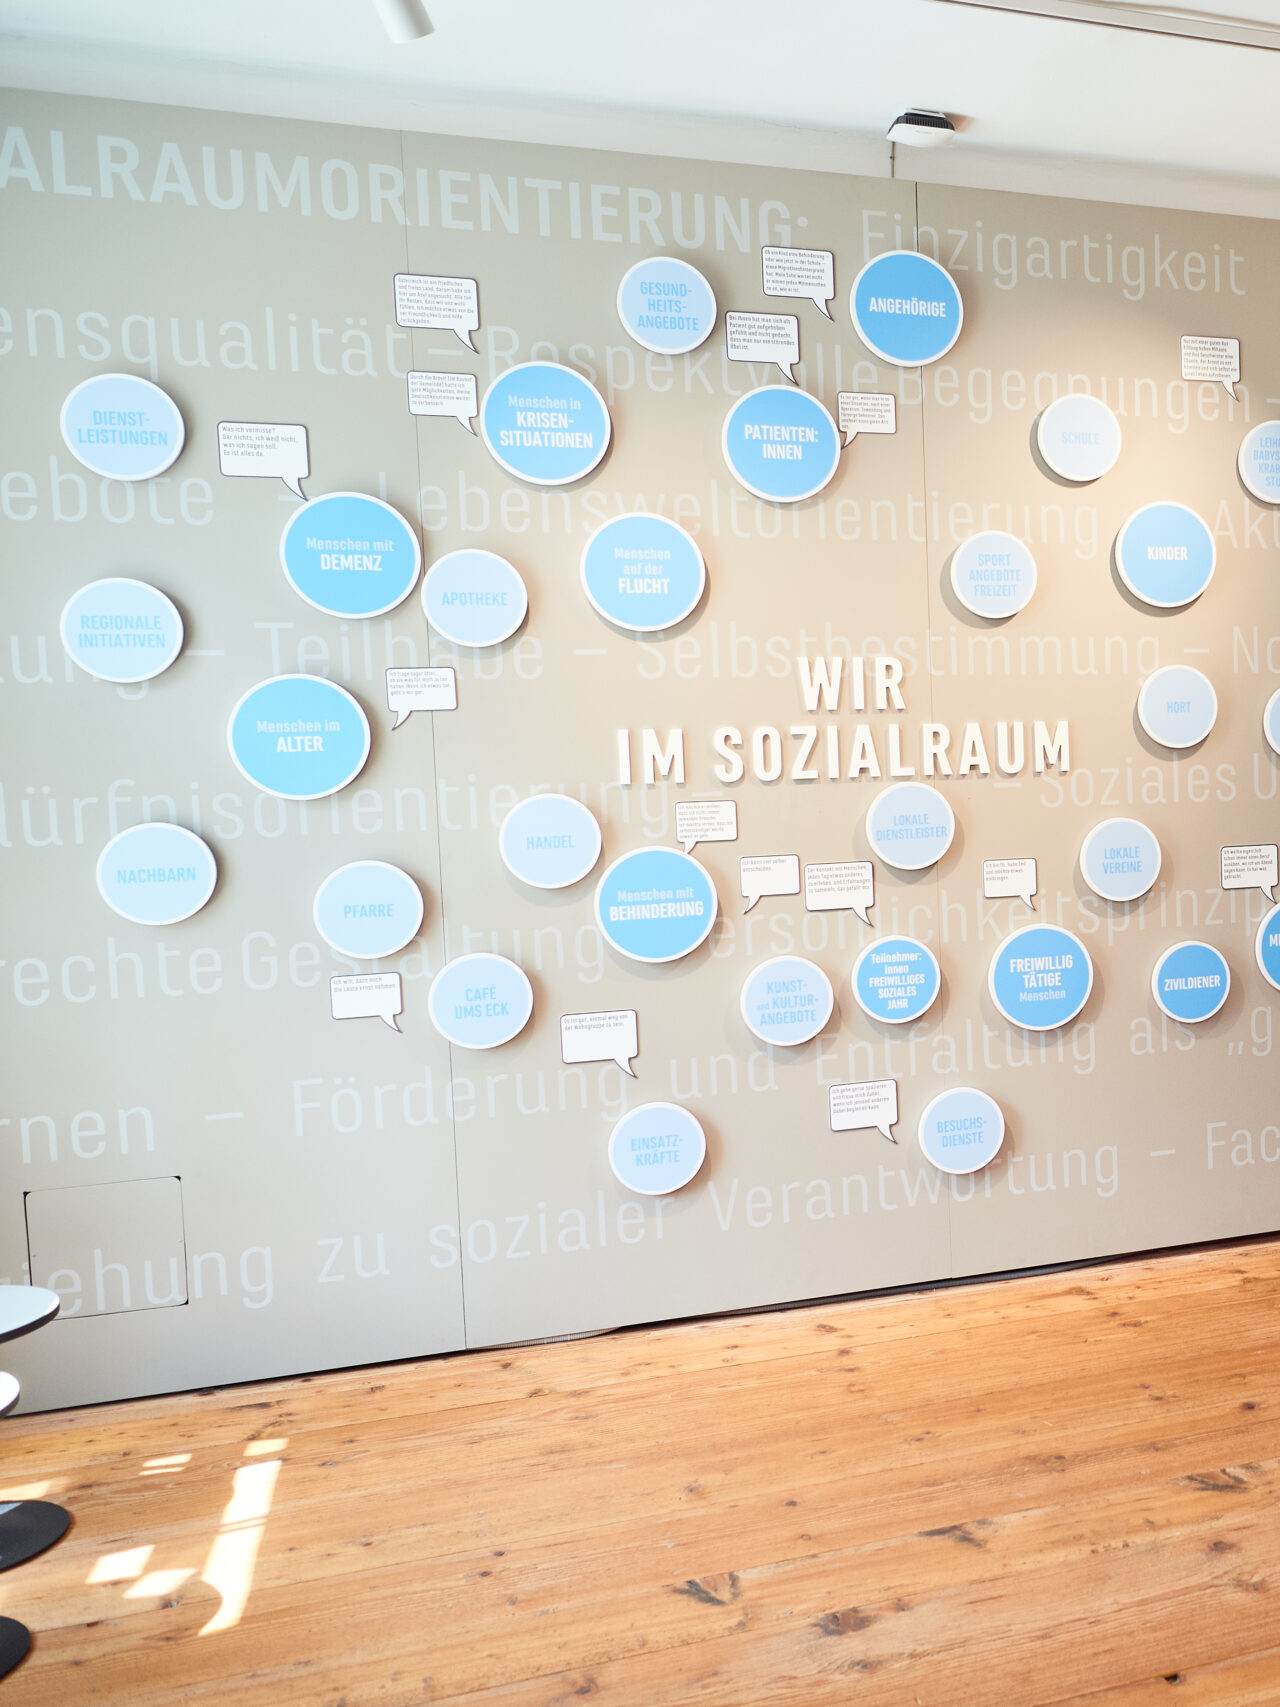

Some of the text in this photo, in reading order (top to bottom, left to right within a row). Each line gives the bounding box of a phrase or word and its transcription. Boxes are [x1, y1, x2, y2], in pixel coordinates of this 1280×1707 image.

[862, 209, 1245, 300] Einzigartigkeit
[640, 281, 693, 298] GESUND-
[647, 297, 687, 315] HEITS-
[868, 294, 946, 318] ANGEHÖRIGE
[637, 313, 699, 332] ANGEBOTE
[507, 394, 582, 411] Menschen in
[93, 410, 150, 428] DIENST-
[516, 411, 574, 431] KRISEN-
[77, 427, 169, 448] LEISTUNGEN
[499, 428, 594, 450] SITUATIONEN
[744, 424, 819, 443] PATIENTEN:
[1061, 430, 1100, 446] SCHULE
[762, 444, 803, 461] INNEN
[306, 536, 394, 552] Menschen mit
[320, 553, 383, 572] DEMENZ
[614, 547, 671, 562] Menschen
[978, 553, 1011, 567] SPORT
[1147, 546, 1188, 561] KINDER
[623, 562, 664, 577] auf der
[969, 568, 1022, 583] ANGEBOTE
[618, 577, 670, 595] FLUCHT
[974, 583, 1018, 598] FREIZEIT
[441, 591, 508, 607] APOTHEKE
[80, 613, 162, 631] REGIONALE
[78, 632, 166, 649] INITIATIVEN
[634, 620, 1160, 686] Selbstbestimmung
[797, 655, 906, 712] WIR
[1166, 701, 1191, 714] HORT
[256, 718, 341, 734] Menschen im
[276, 735, 325, 754] ALTER
[617, 720, 1071, 785] IM SOZIALRAUM
[1040, 760, 1237, 808] Soziales
[893, 813, 929, 828] LOKALE
[526, 834, 575, 850] HANDEL
[875, 825, 948, 842] DIENSTLEISTER
[1104, 846, 1140, 860] LOKALE
[116, 866, 197, 885] NACHBARN
[1102, 860, 1143, 874] VEREINE
[617, 886, 694, 903] Menschen mit
[343, 902, 395, 919] PFARRE
[609, 900, 704, 923] BEHINDERUNG
[870, 952, 922, 965] Teilnehmer:
[1009, 953, 1073, 973] FREIWILLIG
[0, 935, 223, 1008] echte
[884, 964, 909, 975] innen
[766, 980, 808, 995] KUNST-
[868, 973, 925, 987] FREIWILLIGES
[1022, 970, 1062, 990] TÄTIGE
[1163, 973, 1221, 992] ZIVILDIENER
[465, 984, 497, 1003] CAFÉ
[878, 985, 916, 999] SOZIALES
[1019, 988, 1066, 1003] Menschen
[454, 1001, 510, 1021] UMS ECK
[756, 994, 819, 1012] und KULTUR-
[887, 998, 909, 1011] JAHR
[759, 1009, 817, 1027] ANGEBOTE
[0, 1104, 157, 1164] nen
[292, 1063, 630, 1137] Förderung
[667, 1042, 778, 1098] und
[815, 1012, 1097, 1086] Entfaltung
[1129, 1010, 1197, 1057] als
[936, 1118, 987, 1135] BESUCHS-
[630, 1134, 683, 1152] EINSATZ-
[941, 1131, 984, 1149] DIENSTE
[635, 1147, 680, 1167] KRÄFTE
[0, 1247, 275, 1316] ehung
[317, 1231, 391, 1285] zu
[427, 1189, 674, 1270] sozialer
